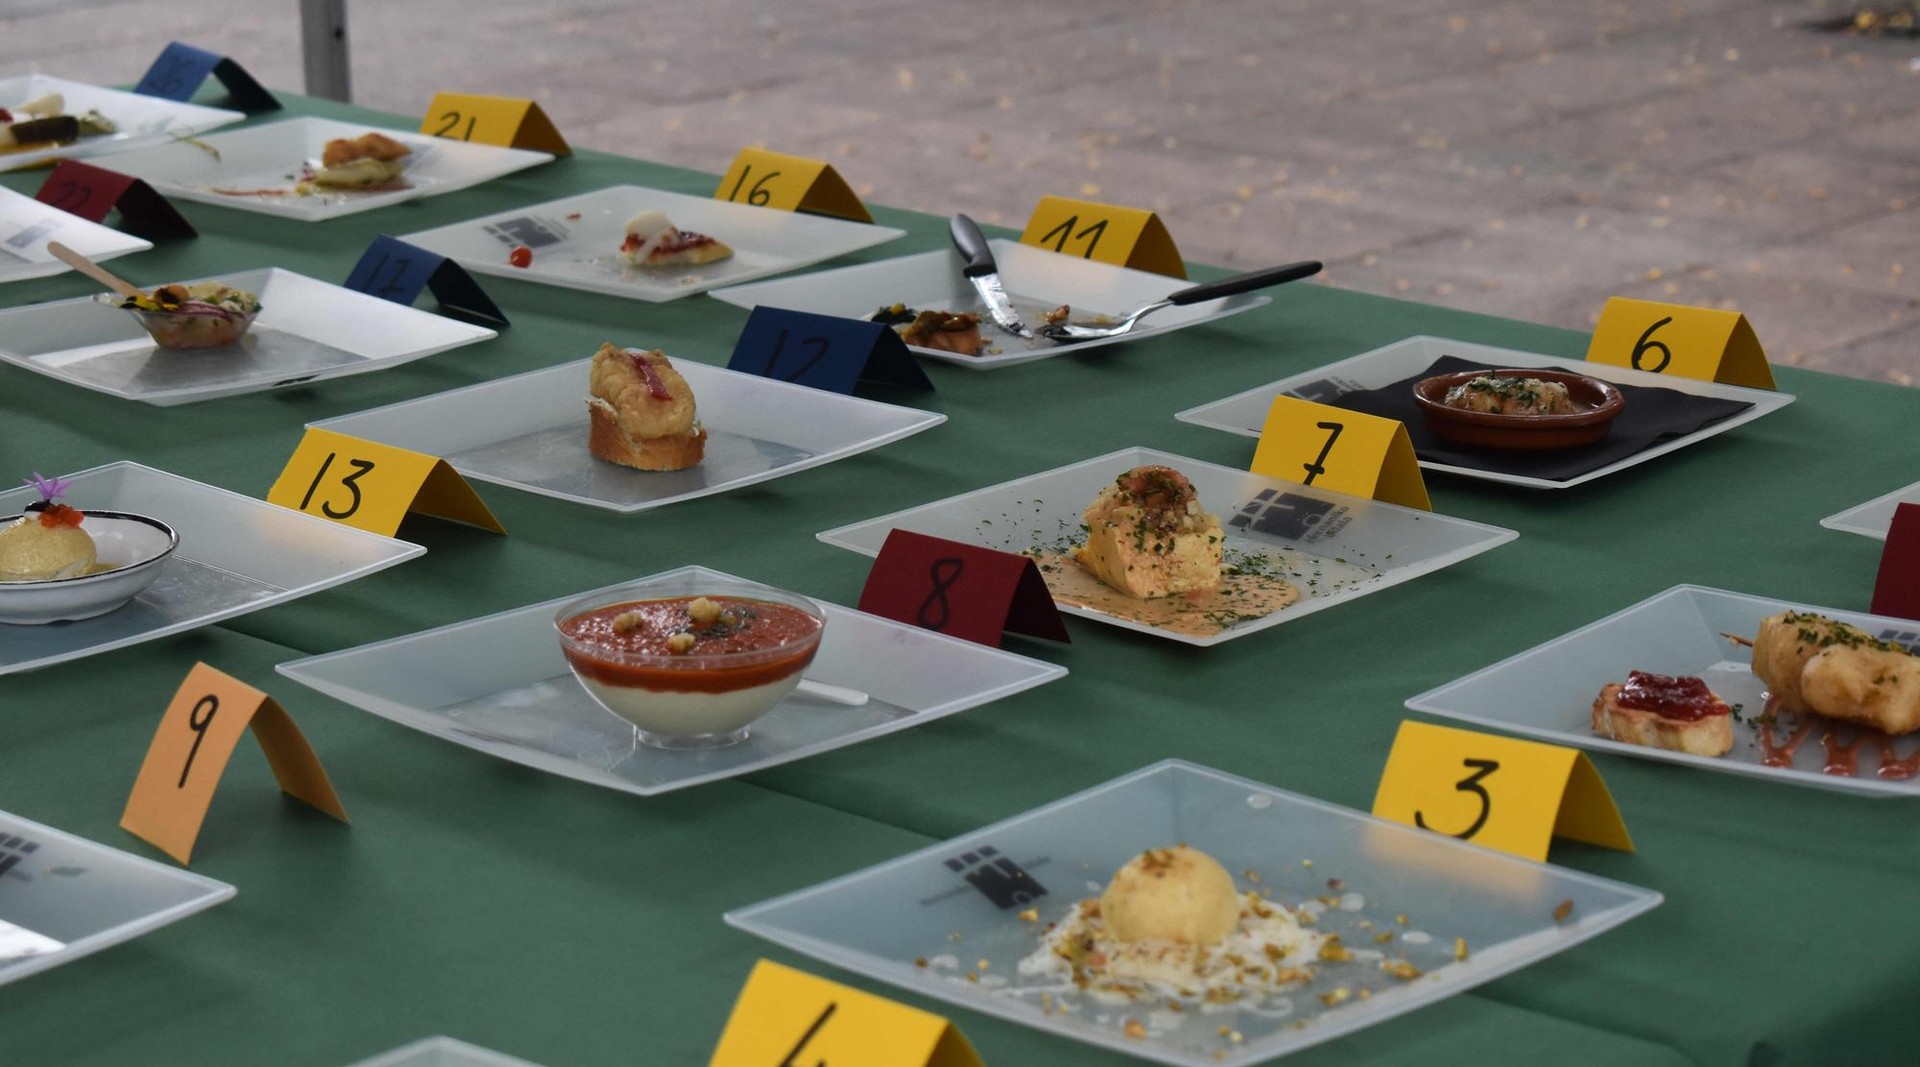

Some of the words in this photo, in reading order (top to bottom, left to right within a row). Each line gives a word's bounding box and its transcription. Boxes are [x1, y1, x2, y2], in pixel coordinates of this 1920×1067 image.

[433, 111, 476, 142] 21
[729, 164, 781, 207] 16
[1040, 214, 1108, 259] 11
[764, 329, 829, 382] 12
[1631, 316, 1673, 374] 6
[1302, 421, 1343, 486] 7
[300, 452, 375, 519] 13
[917, 558, 964, 631] 8
[178, 694, 219, 789] 9
[1414, 758, 1500, 840] 3
